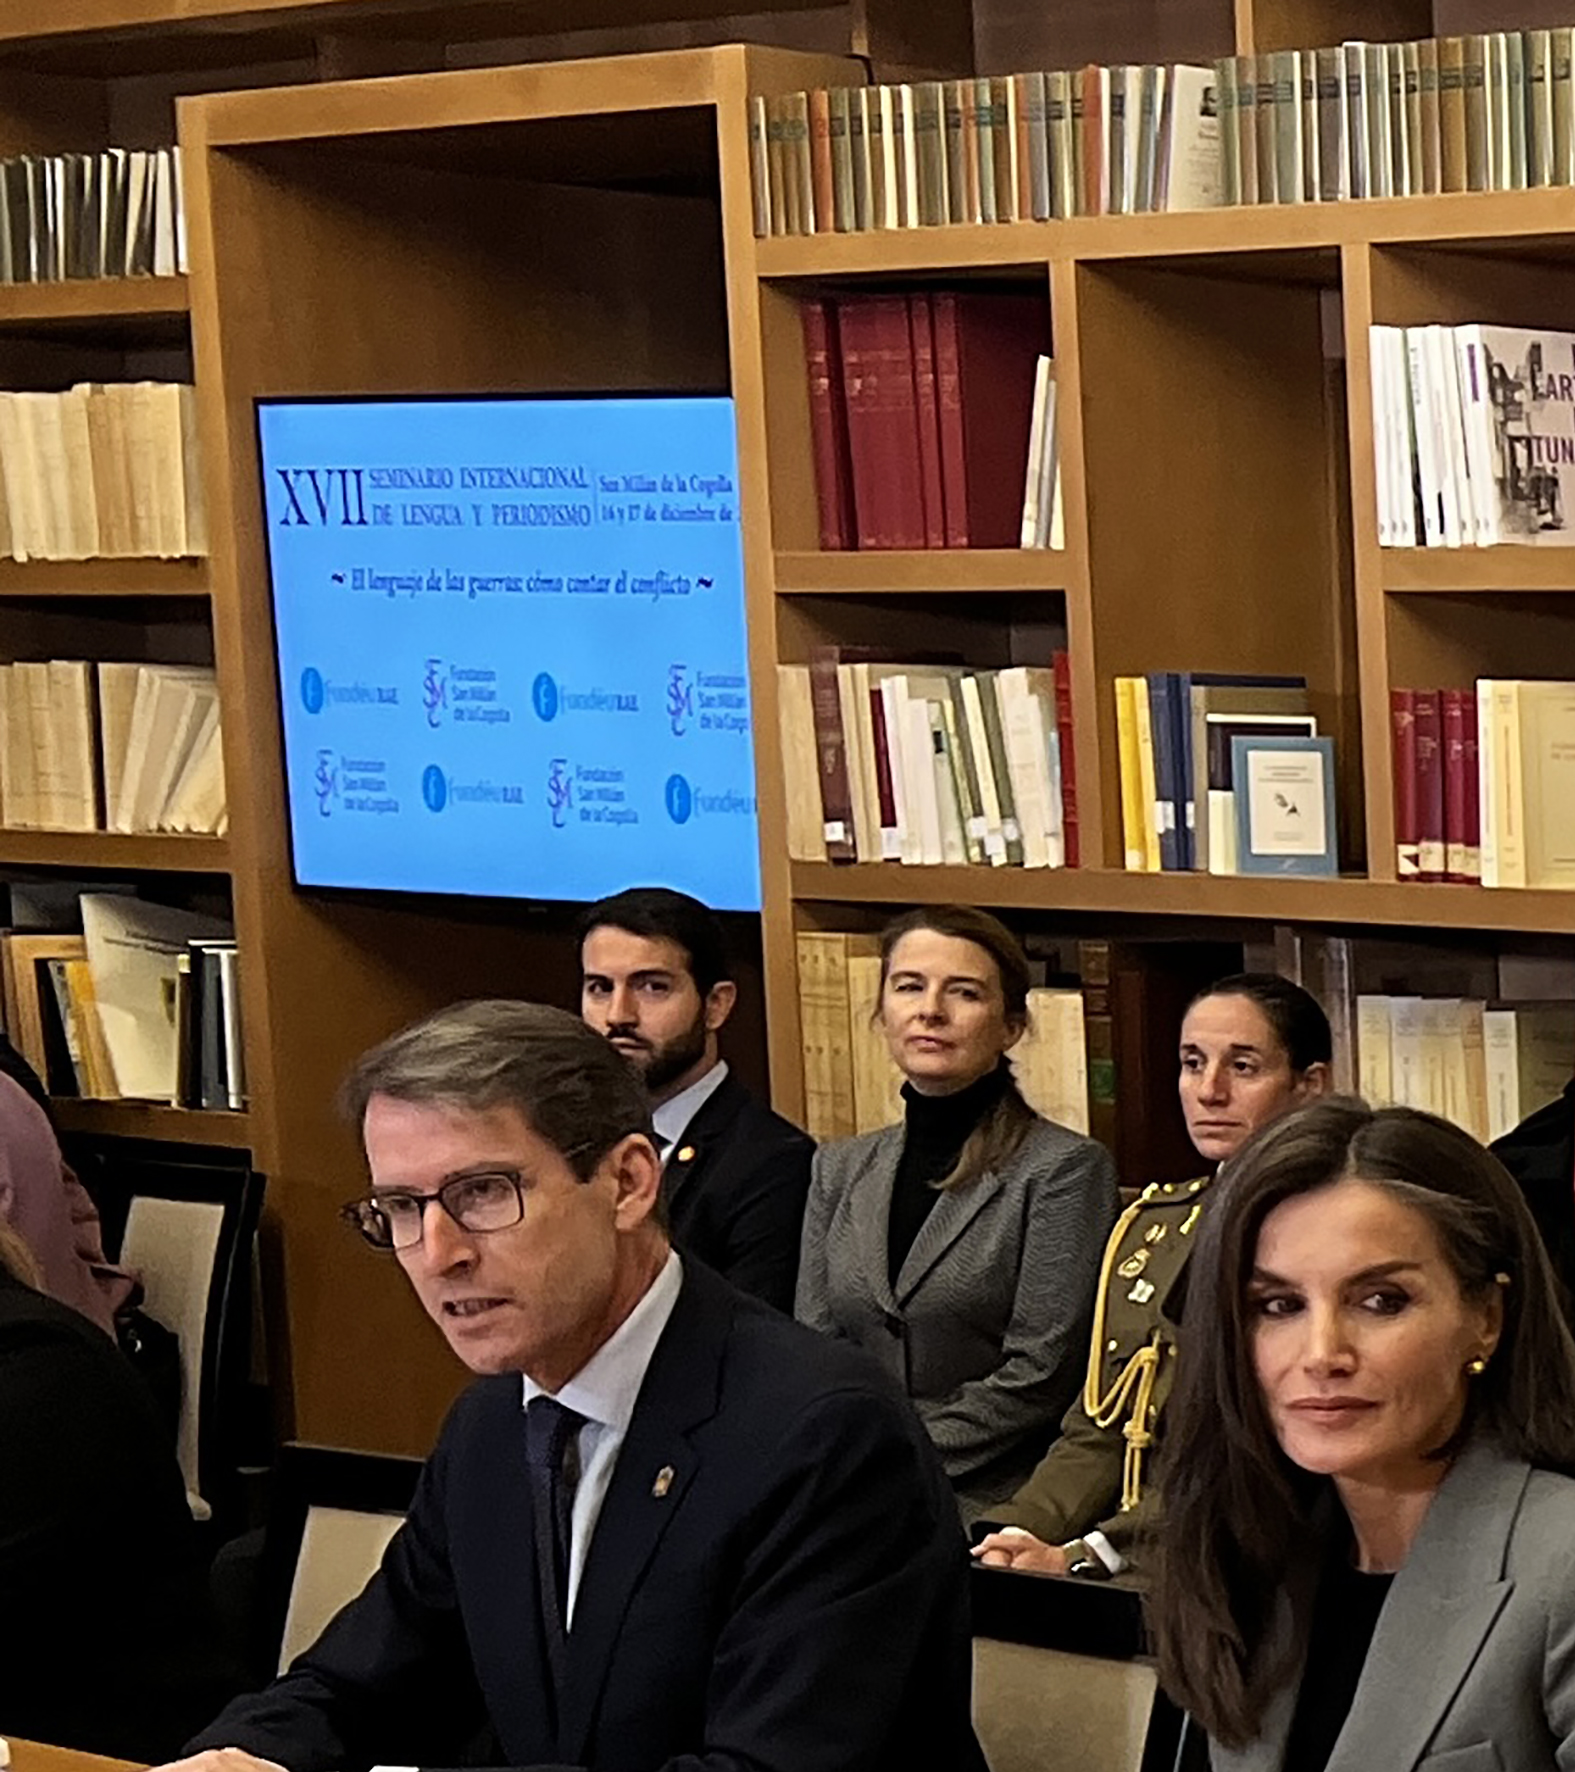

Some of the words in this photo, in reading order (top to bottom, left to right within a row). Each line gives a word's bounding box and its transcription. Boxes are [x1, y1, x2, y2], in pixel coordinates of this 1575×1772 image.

[369, 468, 453, 489] SEMINARIO
[460, 466, 589, 488] INTERNACIONAL
[276, 468, 368, 526] XVII
[372, 503, 393, 526] DE
